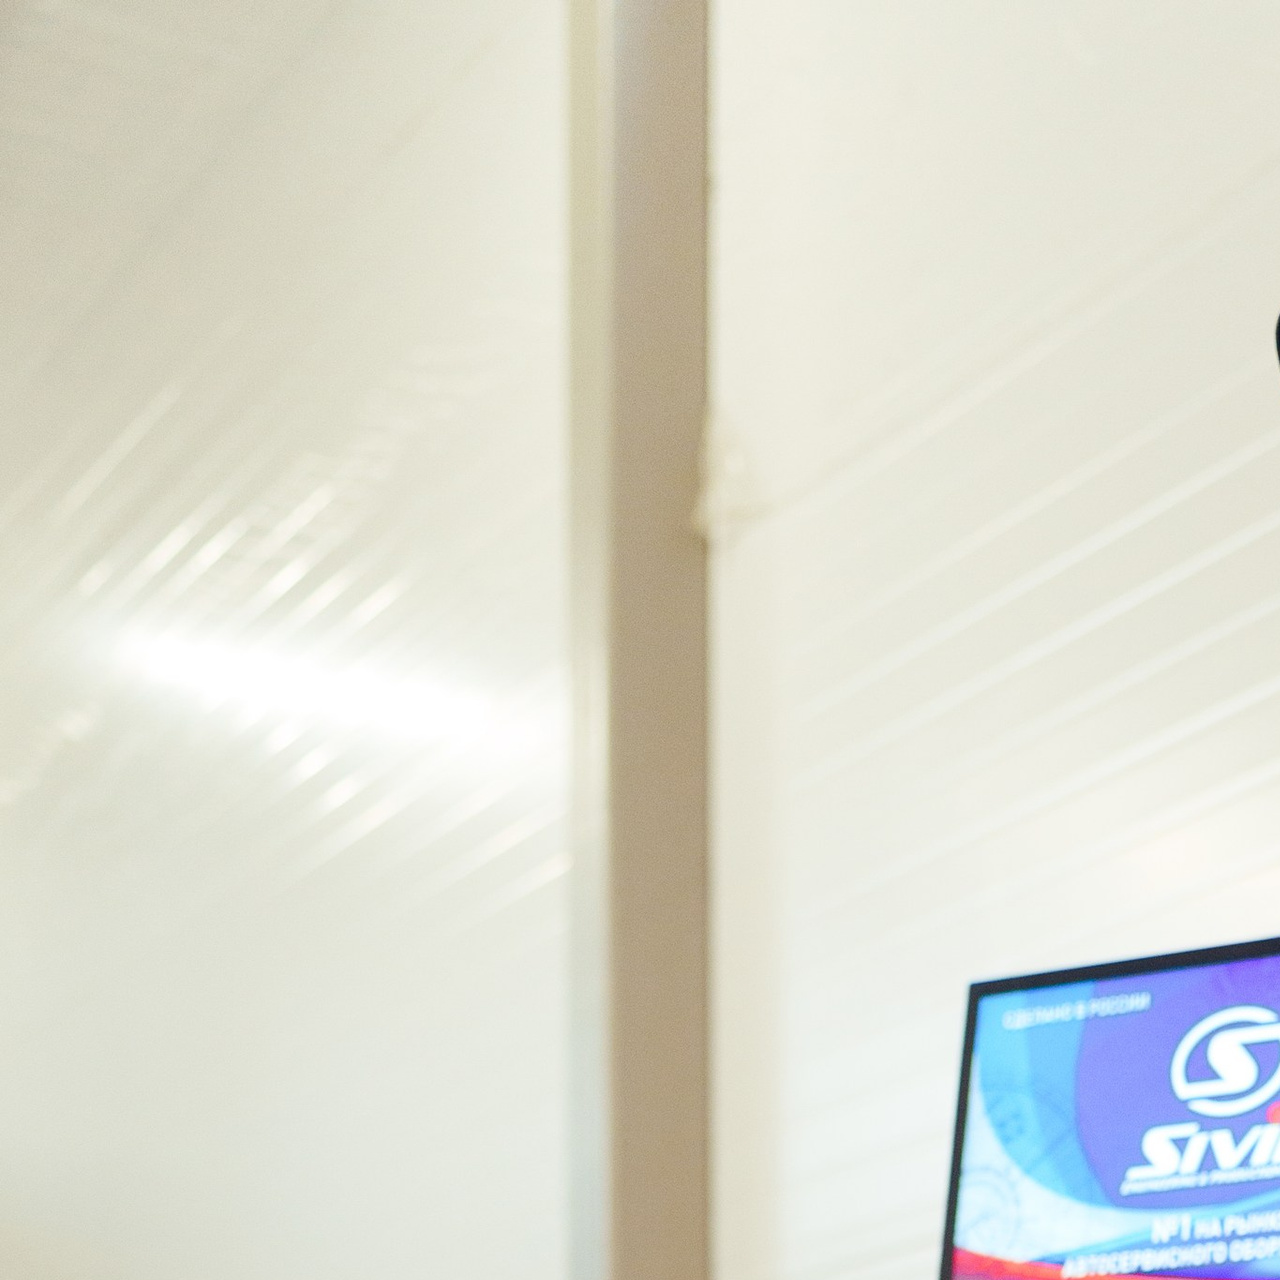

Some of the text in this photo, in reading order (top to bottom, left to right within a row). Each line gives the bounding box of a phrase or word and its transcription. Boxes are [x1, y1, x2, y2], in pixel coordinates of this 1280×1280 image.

[1088, 991, 1152, 1018] РОССИИ
[1194, 1215, 1221, 1240] НА
[1061, 1241, 1228, 1280] АВТОСЕРВИСНОГО
